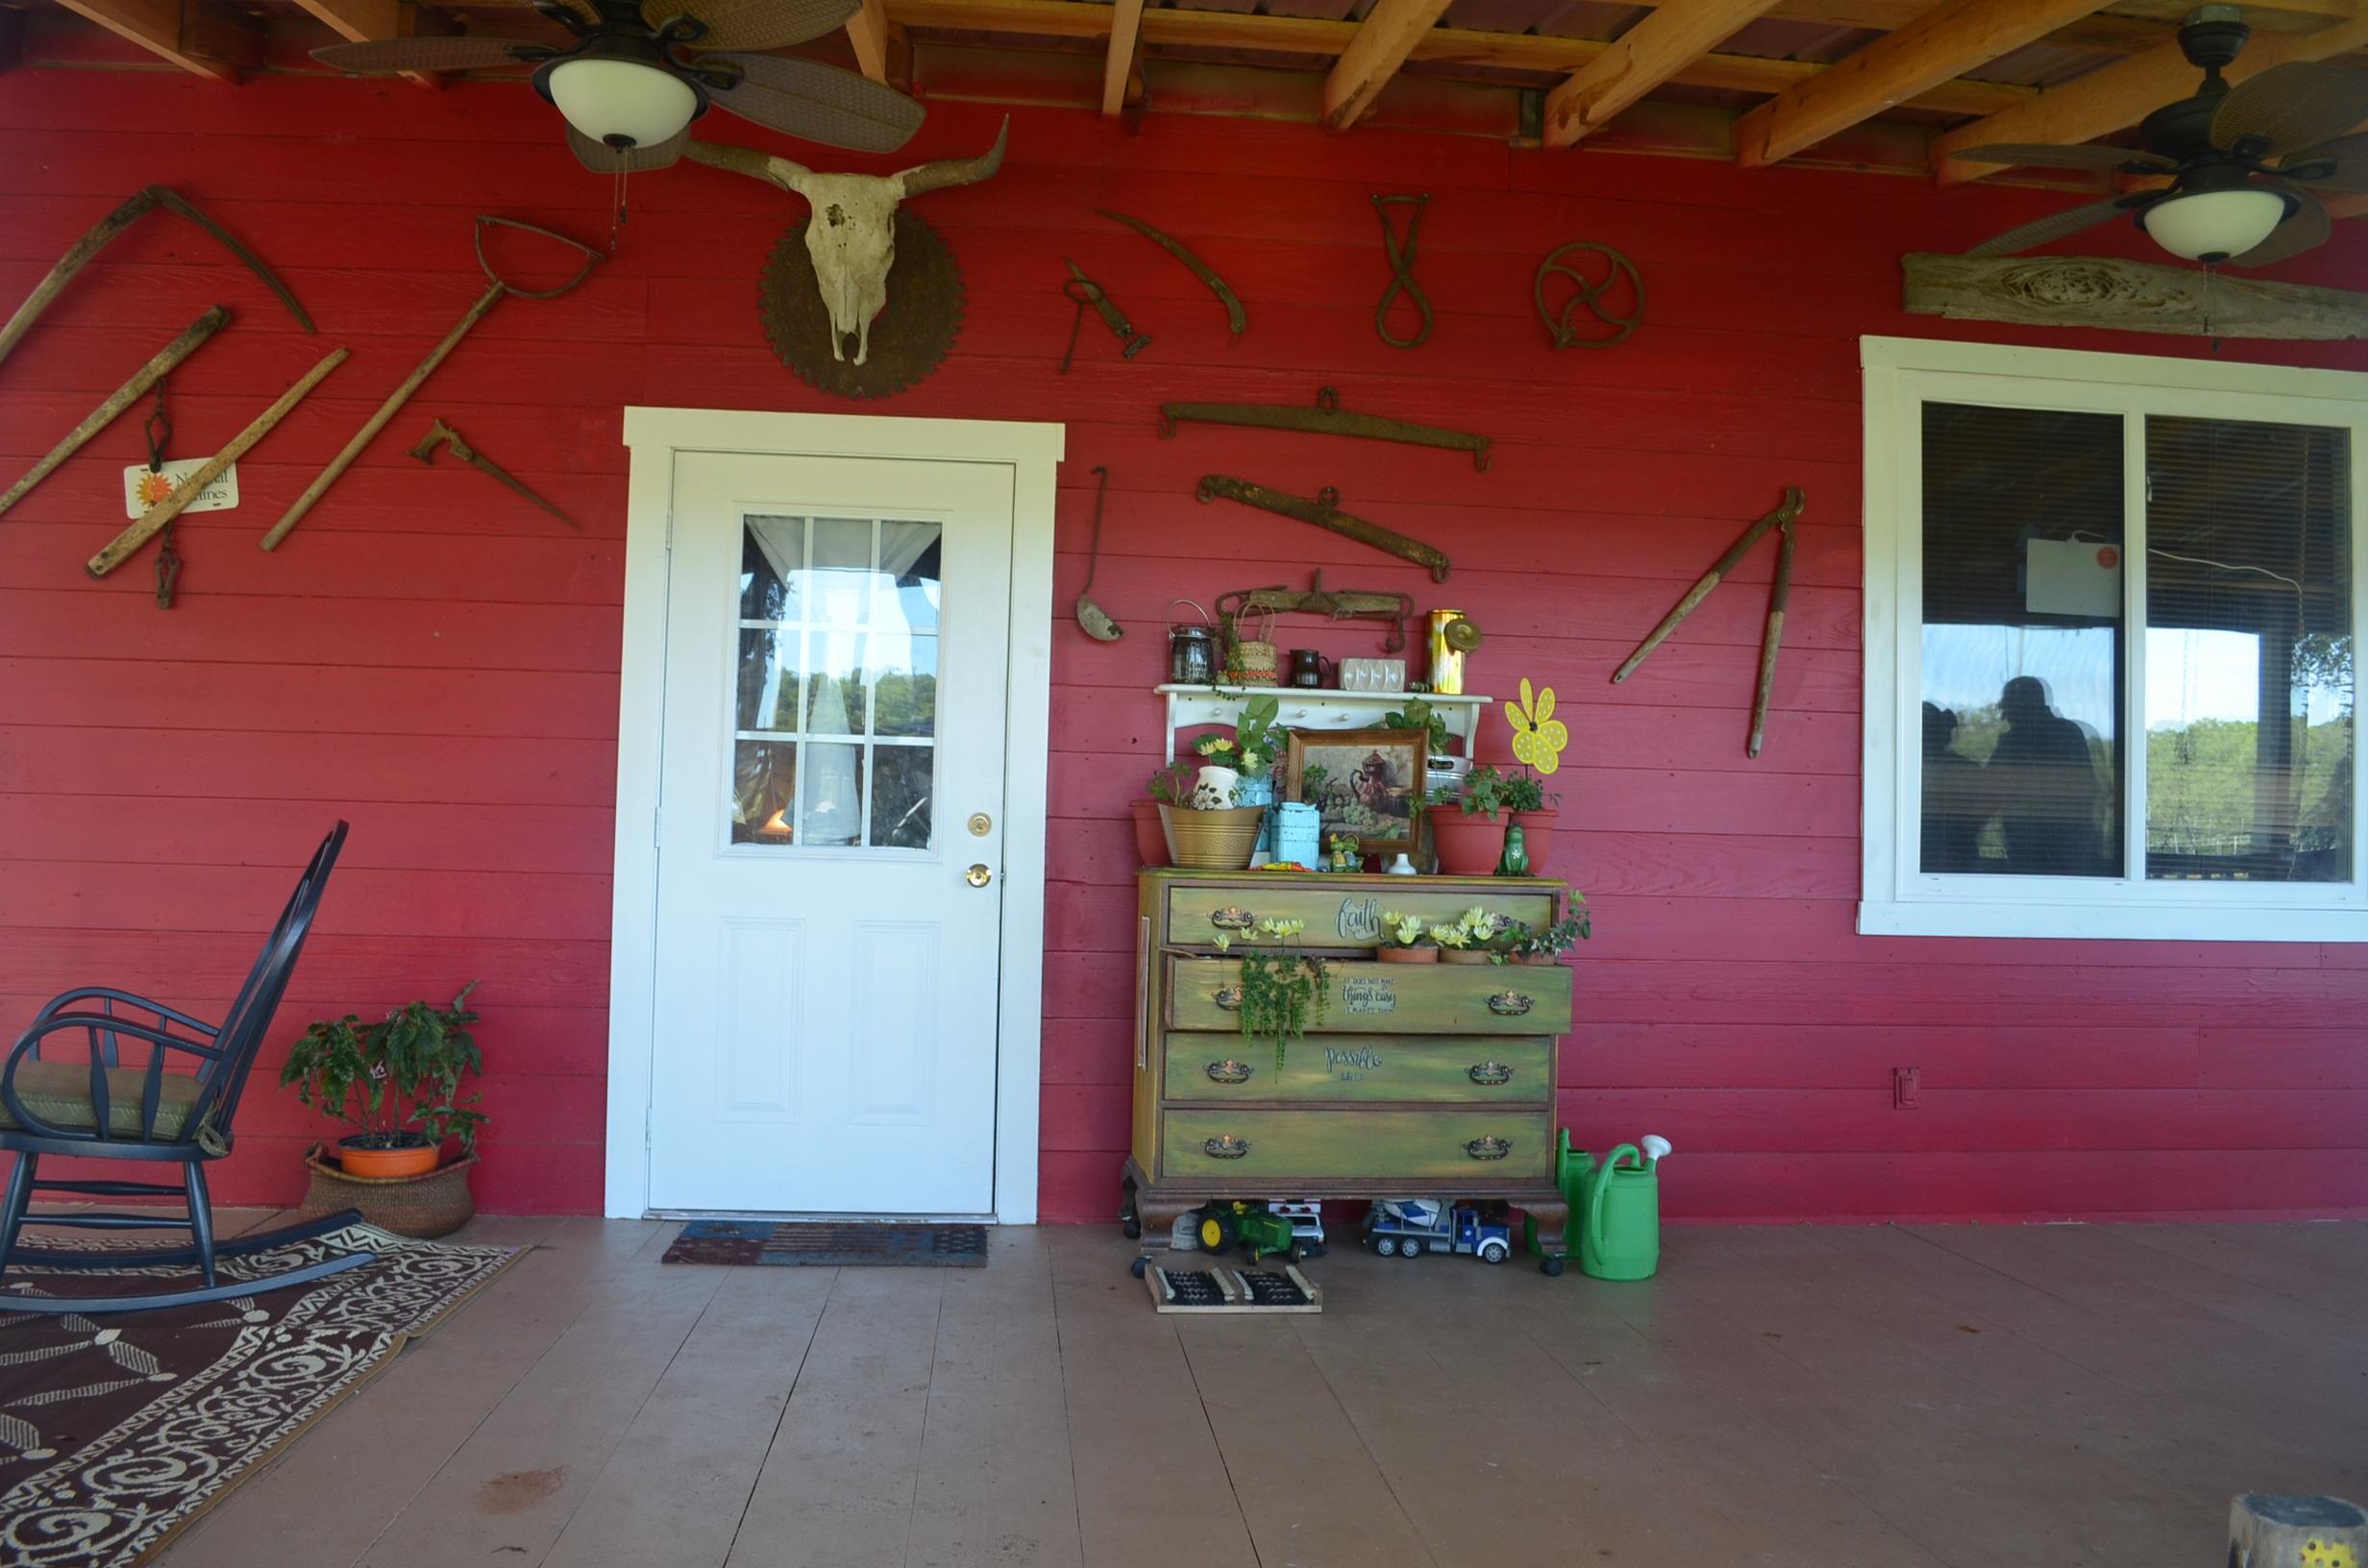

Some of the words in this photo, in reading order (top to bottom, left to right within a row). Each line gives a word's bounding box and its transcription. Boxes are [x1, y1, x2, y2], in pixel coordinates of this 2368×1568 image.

[1337, 898, 1385, 941] faith
[1343, 985, 1373, 1007] things
[1324, 1046, 1383, 1073] possible
